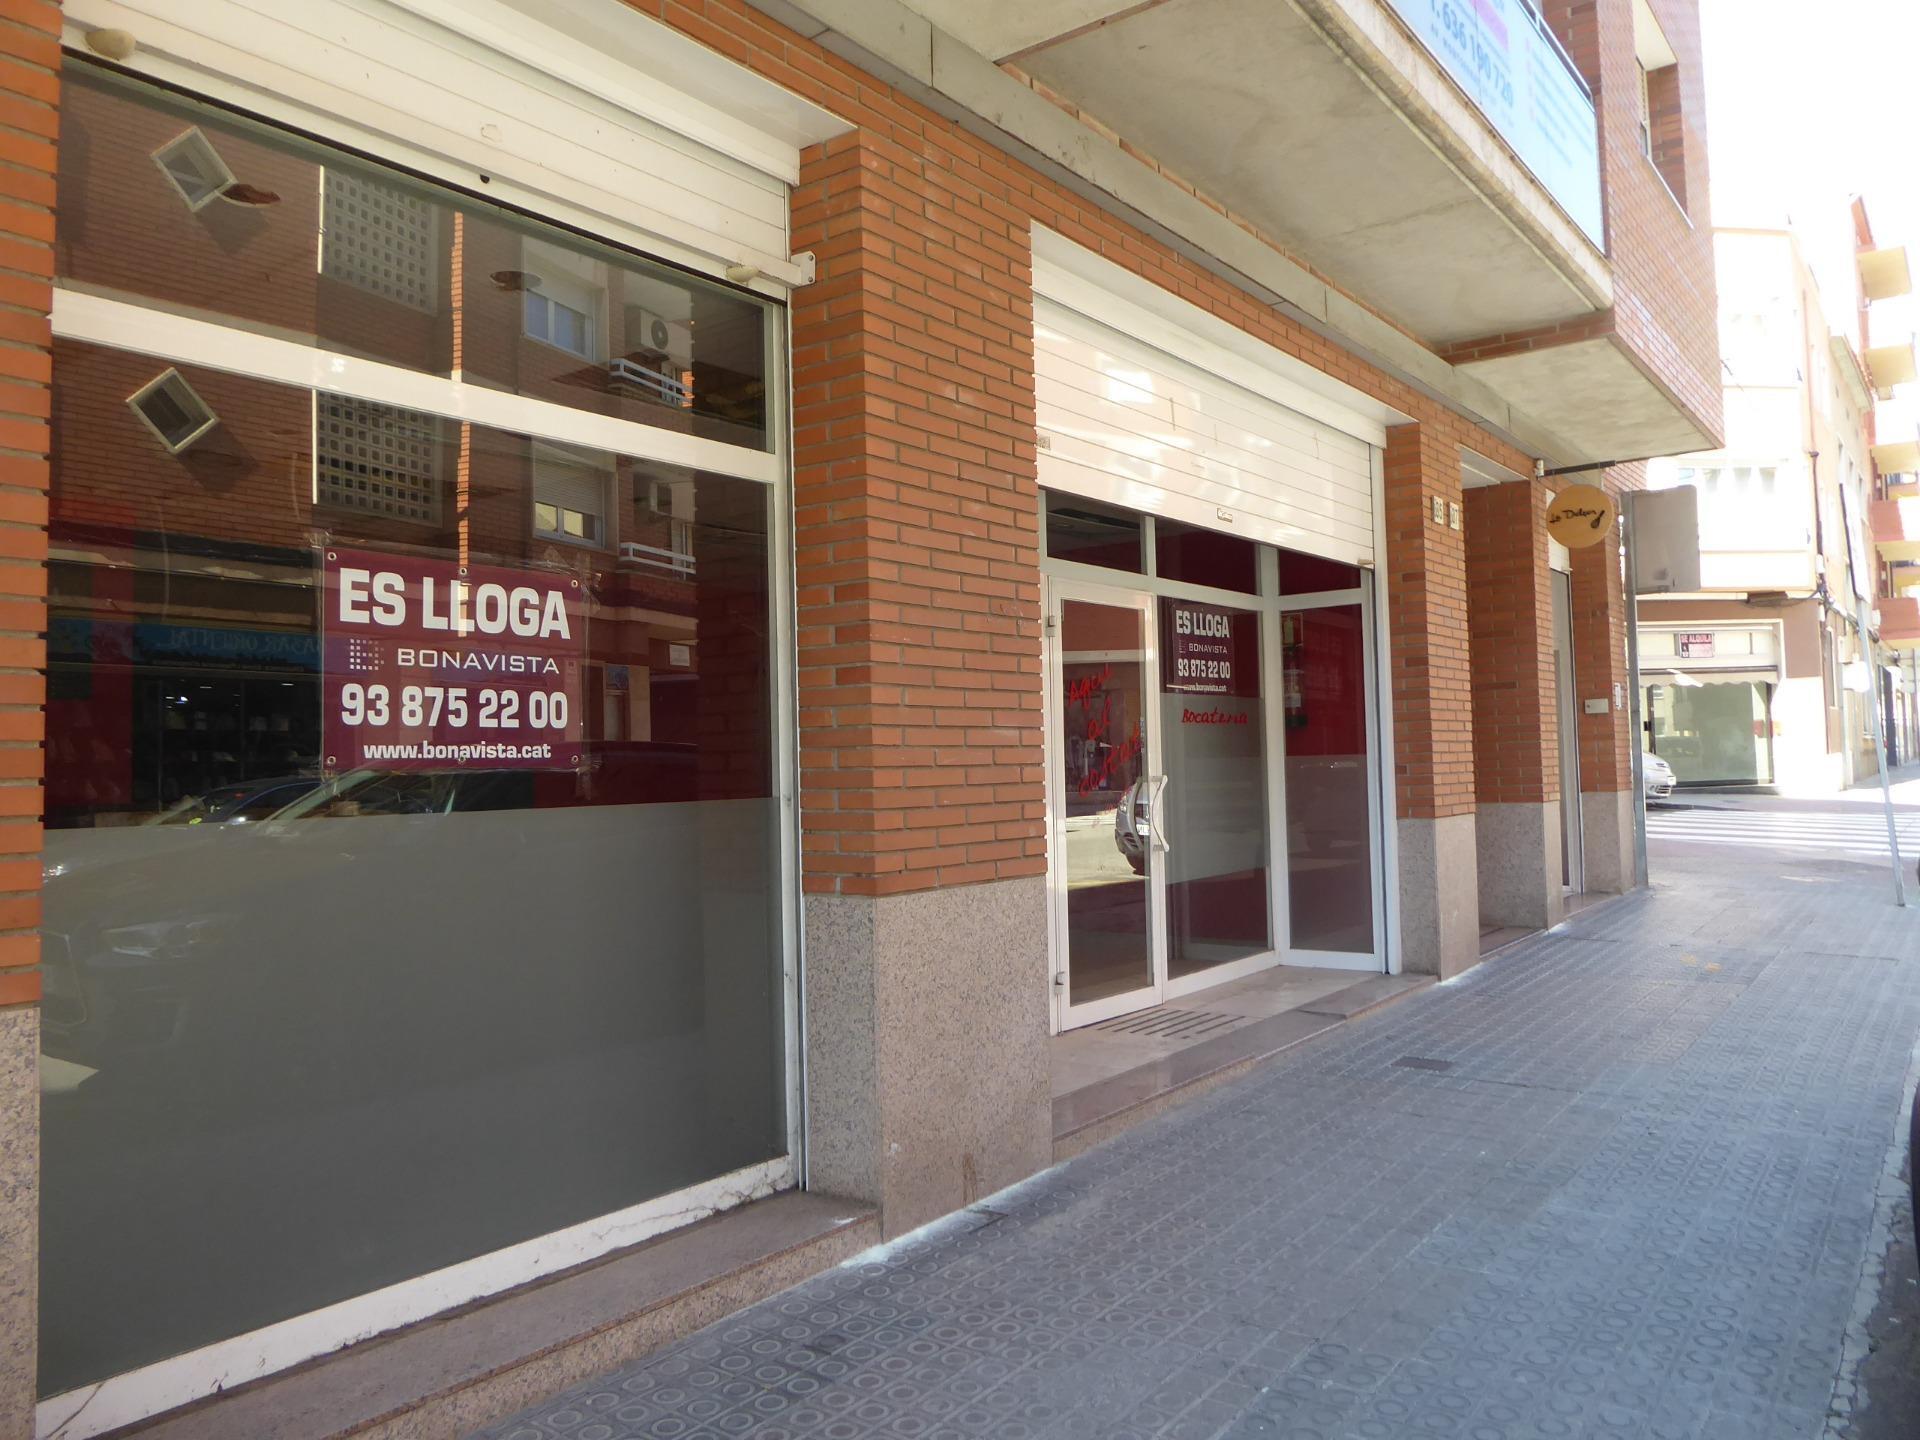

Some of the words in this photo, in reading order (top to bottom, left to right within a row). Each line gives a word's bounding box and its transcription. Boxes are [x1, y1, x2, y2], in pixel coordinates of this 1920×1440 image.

[339, 567, 406, 626] ES
[422, 576, 571, 640] LLOGA
[1176, 609, 1191, 634] ES
[1193, 612, 1230, 638] LLOGA
[397, 648, 559, 674] BONAVISTA
[1189, 643, 1228, 655] BONAVISTA
[1178, 658, 1189, 677] 93
[1190, 659, 1206, 678] 875
[1207, 660, 1219, 679] 22
[1220, 661, 1231, 679] 00
[341, 683, 390, 726] 93
[401, 686, 468, 727] 875
[478, 689, 520, 728] 22
[528, 691, 568, 729] 00
[363, 741, 551, 759] www.bonavista.cat
